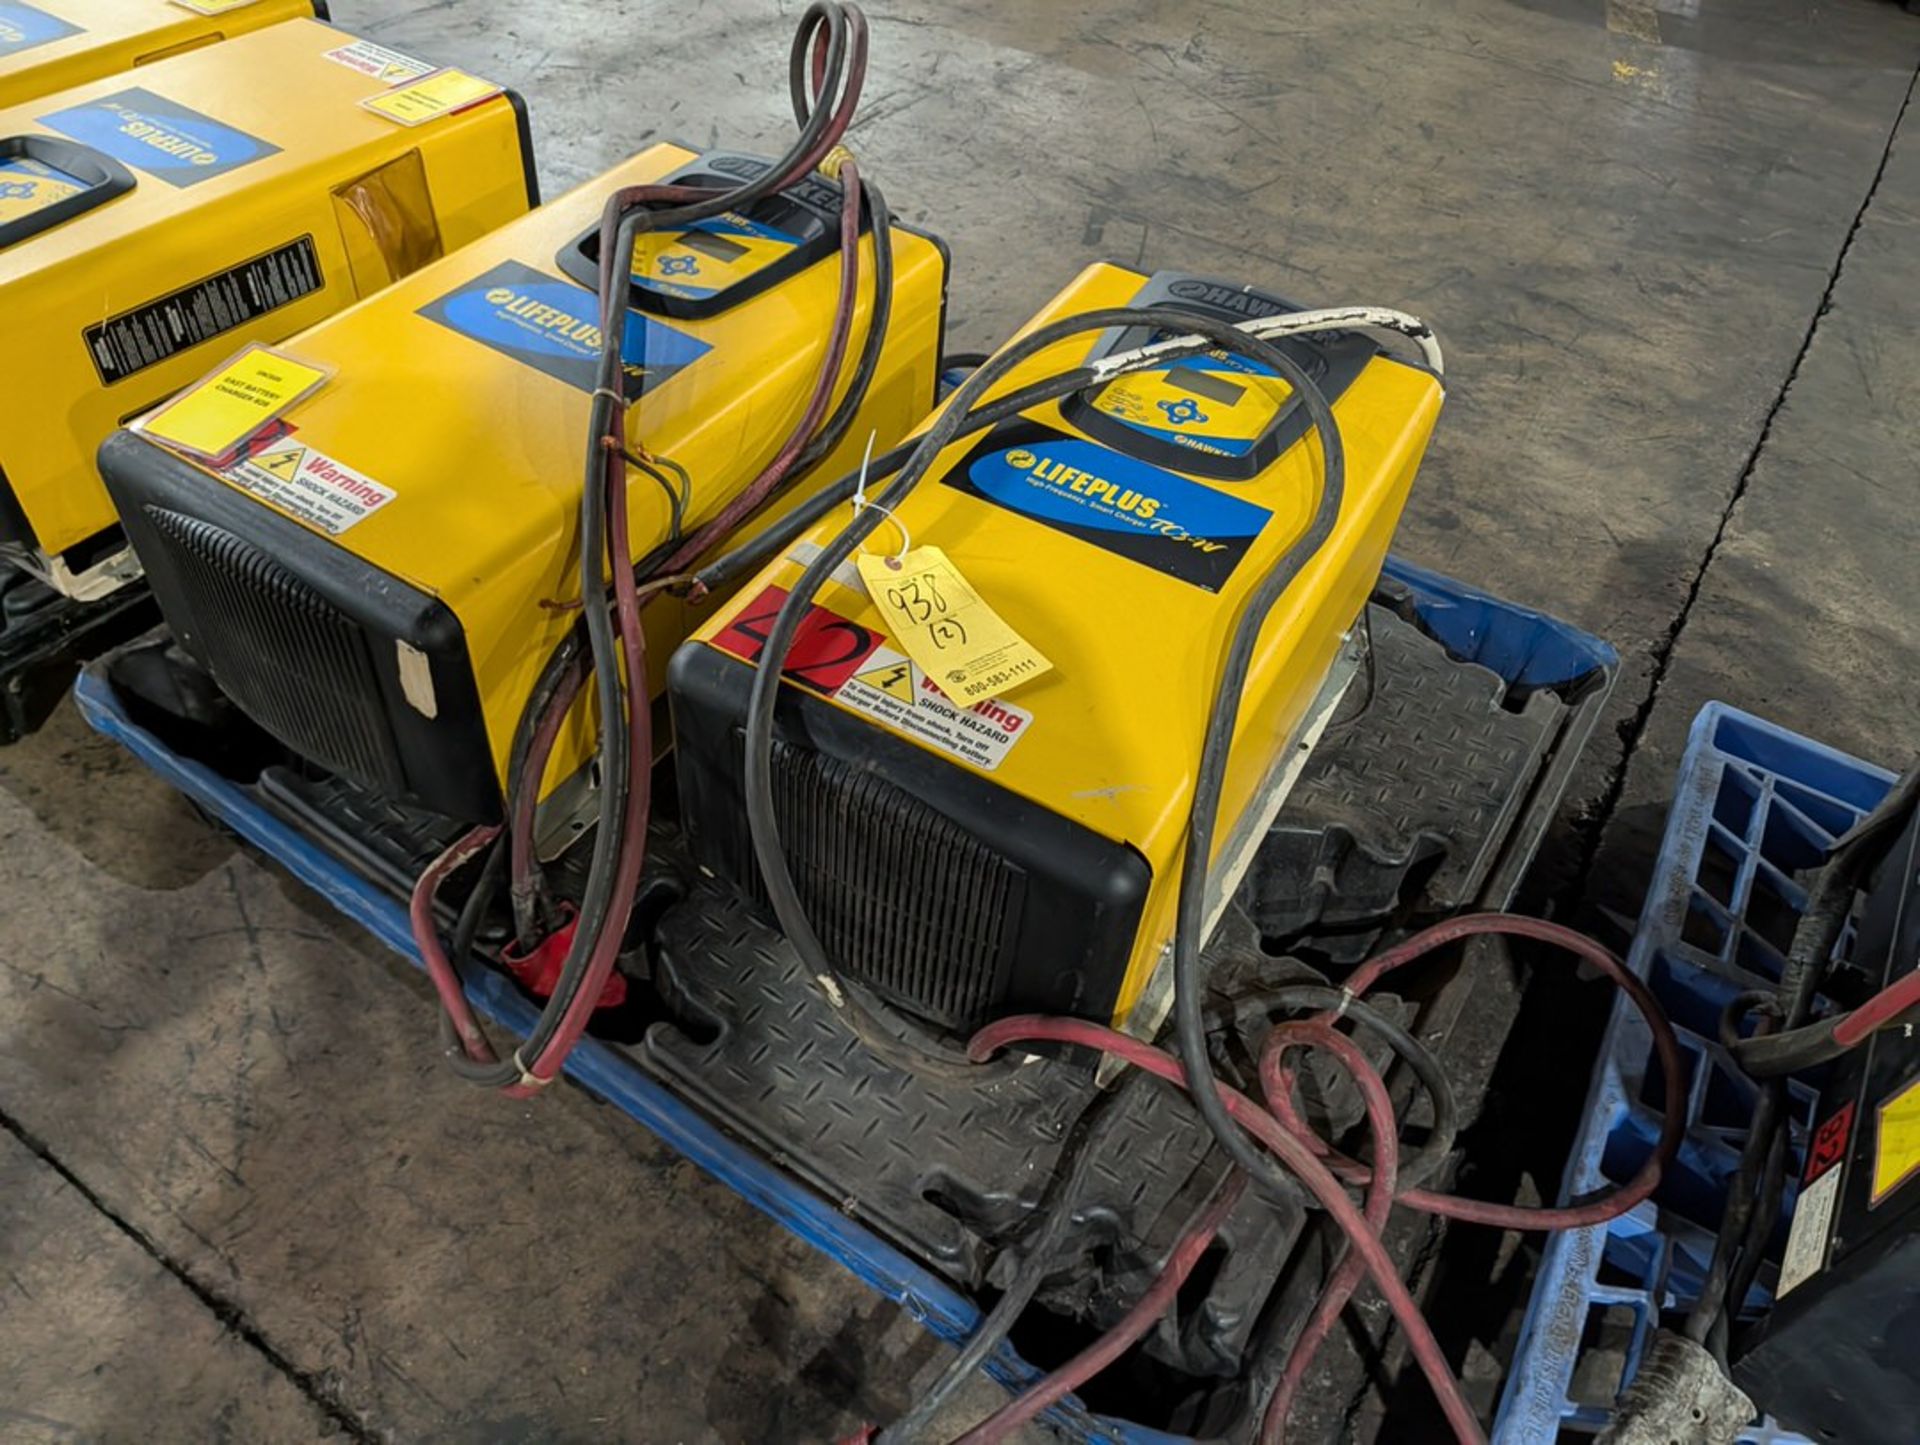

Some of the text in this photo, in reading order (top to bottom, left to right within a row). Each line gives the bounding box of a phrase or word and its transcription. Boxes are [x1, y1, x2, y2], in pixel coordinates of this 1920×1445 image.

[505, 295, 604, 347] LIFEPLUS
[296, 477, 367, 516] SHOCK HAZARD
[304, 456, 386, 508] Warning
[1032, 457, 1160, 519] LIFEPLUS
[1089, 501, 1115, 515] Smart
[1113, 511, 1147, 528] Charger
[887, 574, 947, 624] 938
[929, 618, 966, 650] (2)
[964, 659, 1037, 697] 800-583-1111
[839, 689, 872, 707] Charger
[872, 704, 900, 721] Before
[900, 718, 958, 750] Disconnecting
[857, 687, 881, 701] avoid
[905, 708, 926, 722] from
[956, 732, 974, 745] Turn
[919, 698, 1010, 745] SHOCK HAZARD
